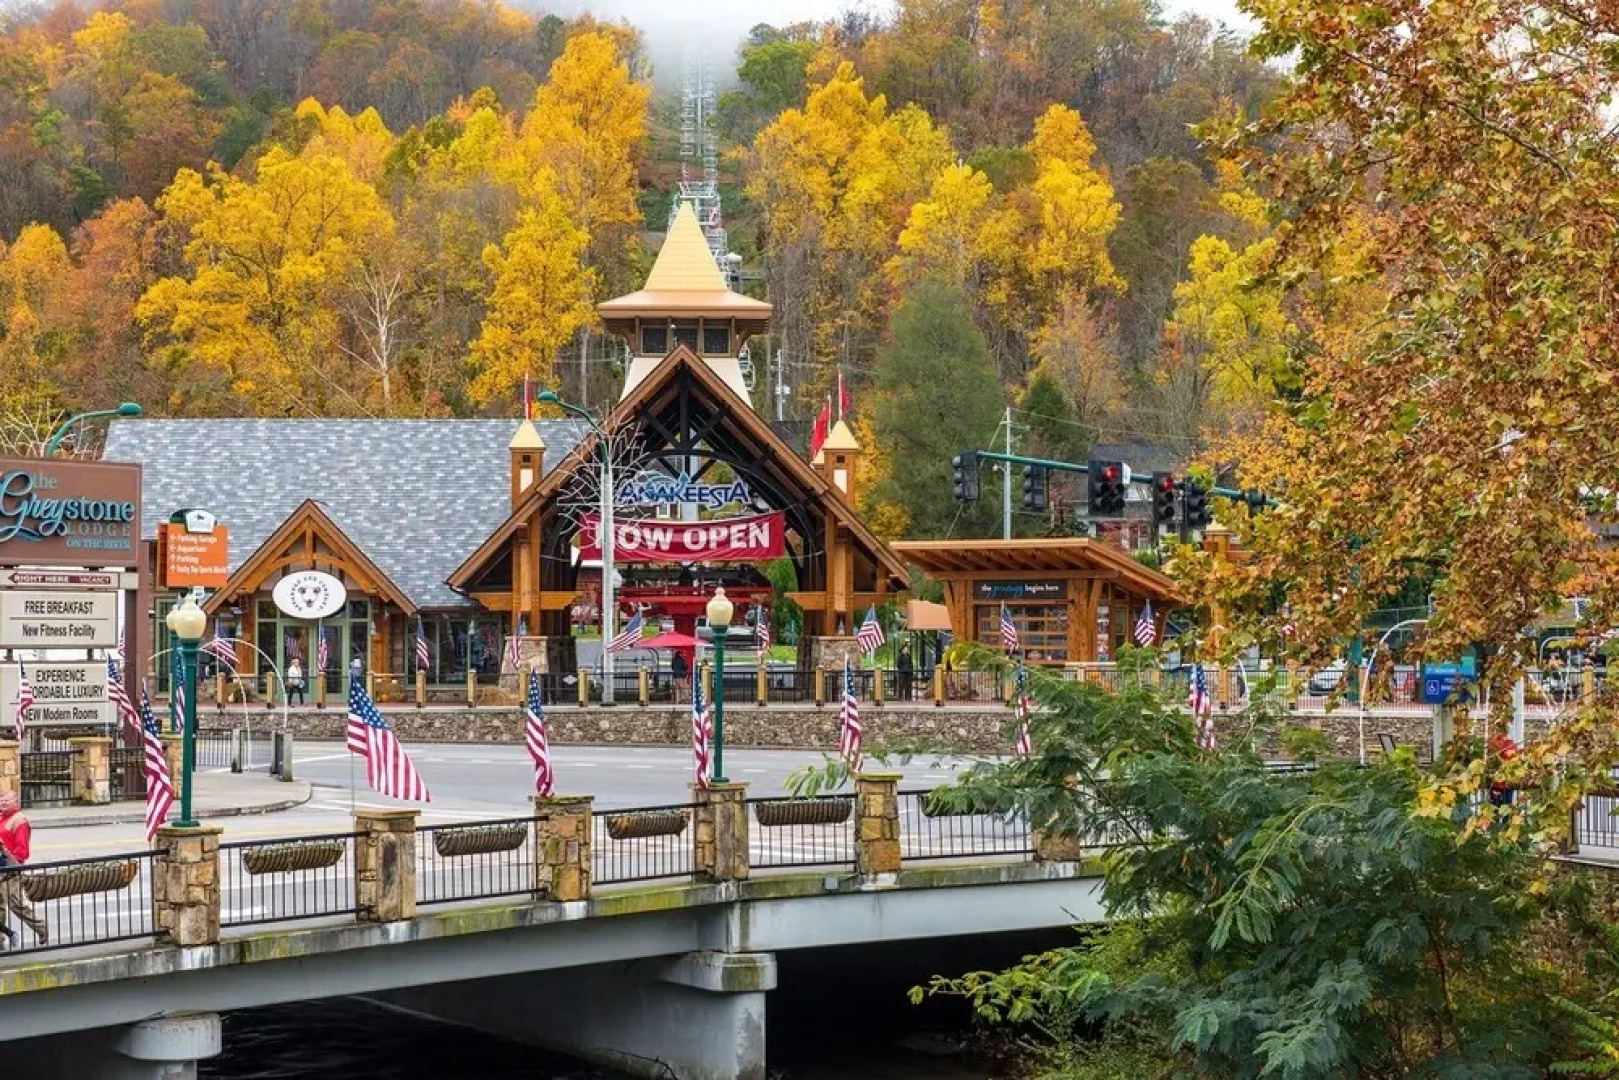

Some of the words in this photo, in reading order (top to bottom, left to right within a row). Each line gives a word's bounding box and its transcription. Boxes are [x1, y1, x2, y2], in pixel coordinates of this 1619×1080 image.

[33, 472, 58, 490] the
[618, 478, 751, 509] ANAKEESTA
[0, 470, 135, 541] Greystone
[66, 521, 131, 537] LODGE
[683, 522, 770, 551] OPEN
[66, 538, 82, 549] ON
[83, 538, 103, 549] THE
[14, 574, 43, 583] RIGHT
[45, 575, 69, 584] HERE
[981, 584, 992, 592] the
[1045, 584, 1060, 592] here
[24, 600, 45, 615] FREE
[47, 601, 94, 615] BREAKFAST
[22, 623, 39, 637] New
[40, 623, 67, 637] Fitness
[69, 623, 96, 640] Facility
[36, 669, 86, 683] EXPERIENCE
[17, 686, 71, 699] ORDABLE
[72, 685, 104, 698] LUXURY
[43, 707, 71, 720] Modern
[73, 706, 99, 720] Rooms
